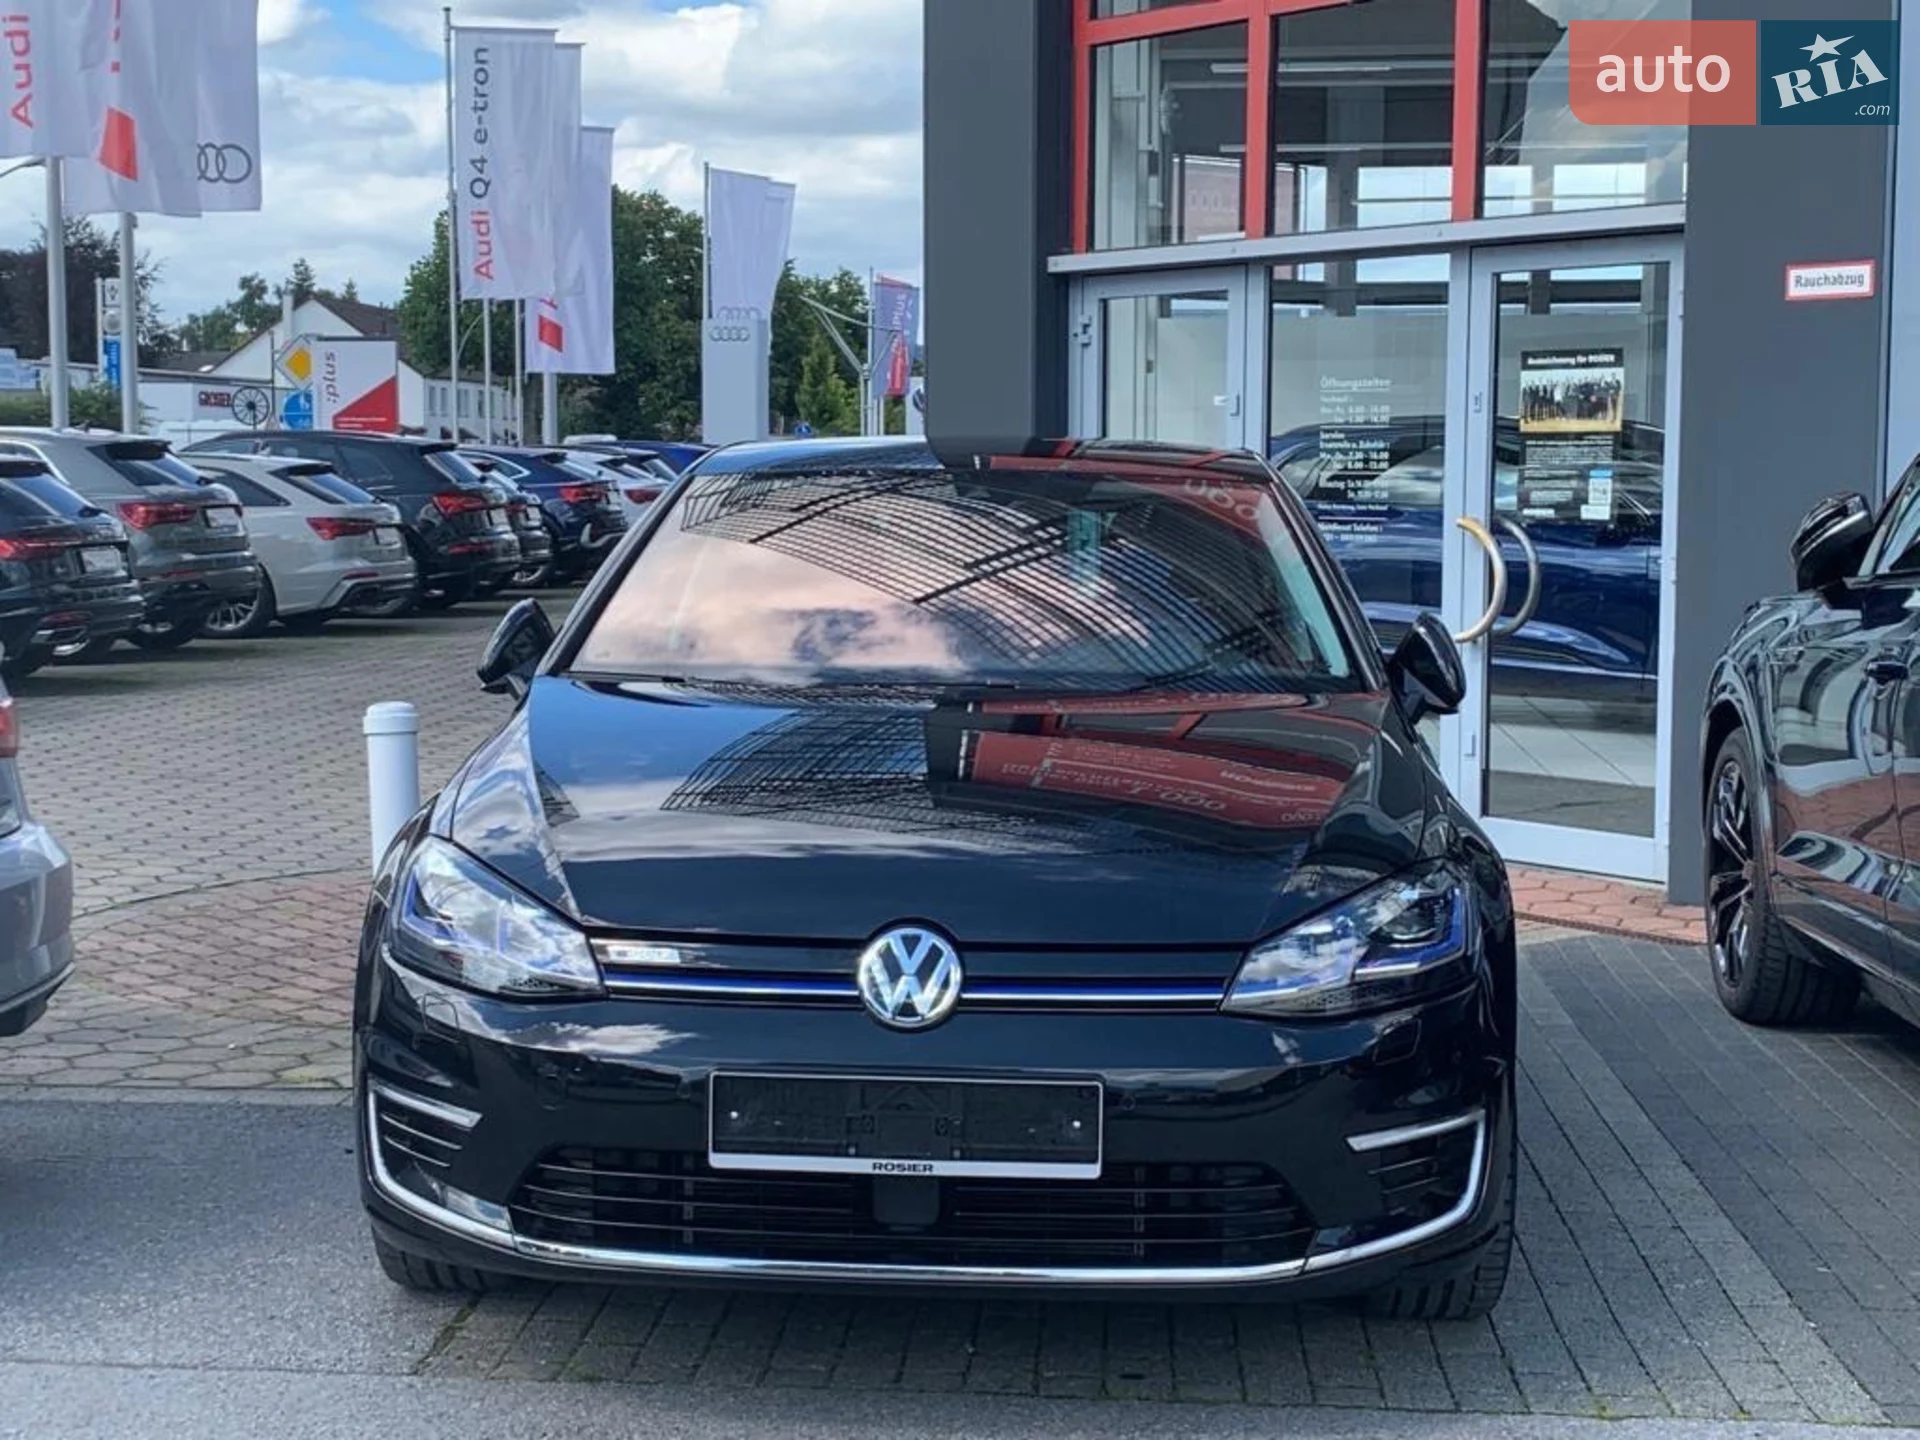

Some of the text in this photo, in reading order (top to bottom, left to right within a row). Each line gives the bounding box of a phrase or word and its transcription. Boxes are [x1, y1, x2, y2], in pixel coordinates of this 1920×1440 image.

[2, 14, 34, 129] Audi
[470, 47, 494, 280] Audi Q4 e-tron
[1794, 273, 1865, 288] Rauchabzug
[872, 1162, 934, 1172] ROSIER
